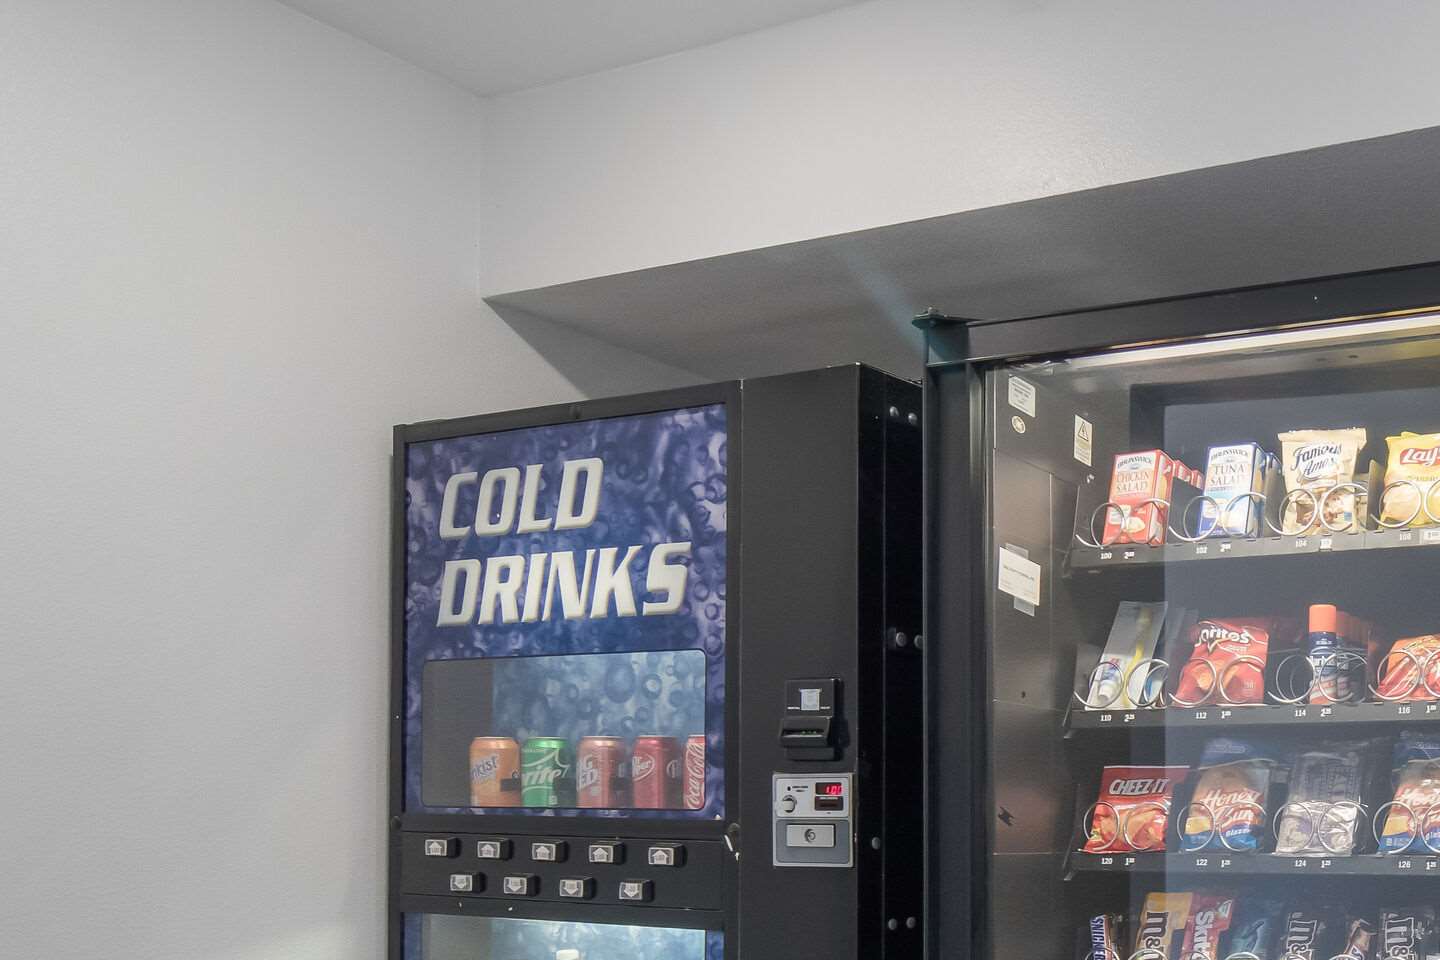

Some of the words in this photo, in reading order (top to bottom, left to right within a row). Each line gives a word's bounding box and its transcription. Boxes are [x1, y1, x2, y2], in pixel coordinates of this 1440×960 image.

[439, 456, 604, 541] COLD
[1213, 463, 1245, 475] TUNA
[436, 541, 692, 628] DRINKS
